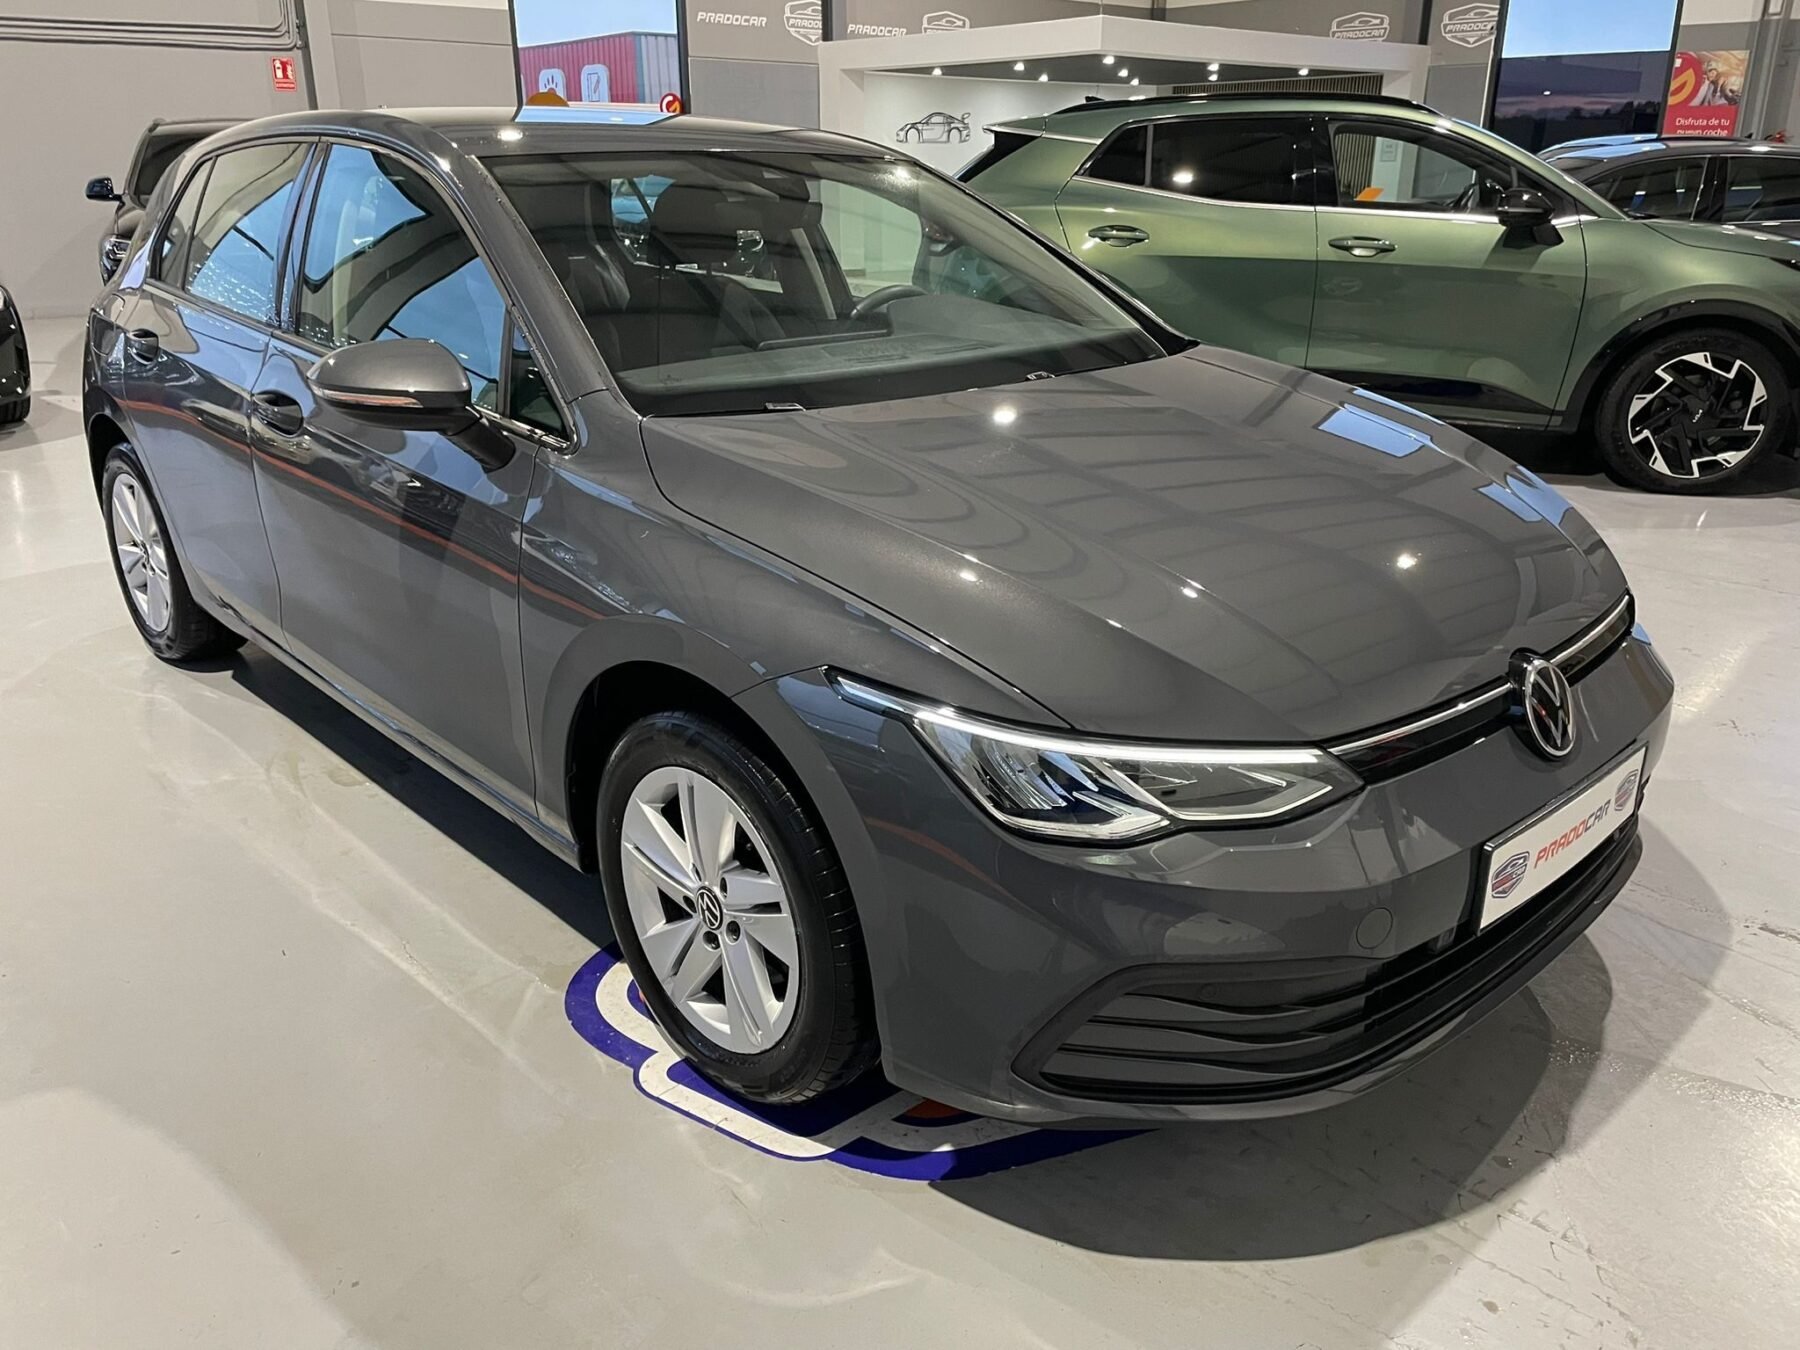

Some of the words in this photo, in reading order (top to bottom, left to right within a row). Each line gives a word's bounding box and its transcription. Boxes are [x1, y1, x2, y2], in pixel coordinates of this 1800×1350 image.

[697, 11, 767, 27] PRADOCAR
[847, 23, 907, 37] PRADOCAR
[1675, 117, 1707, 126] Disfruta
[1708, 117, 1720, 126] de
[1720, 118, 1730, 126] tu
[1703, 128, 1728, 136] coche
[1534, 799, 1612, 869] PRADOCAR
